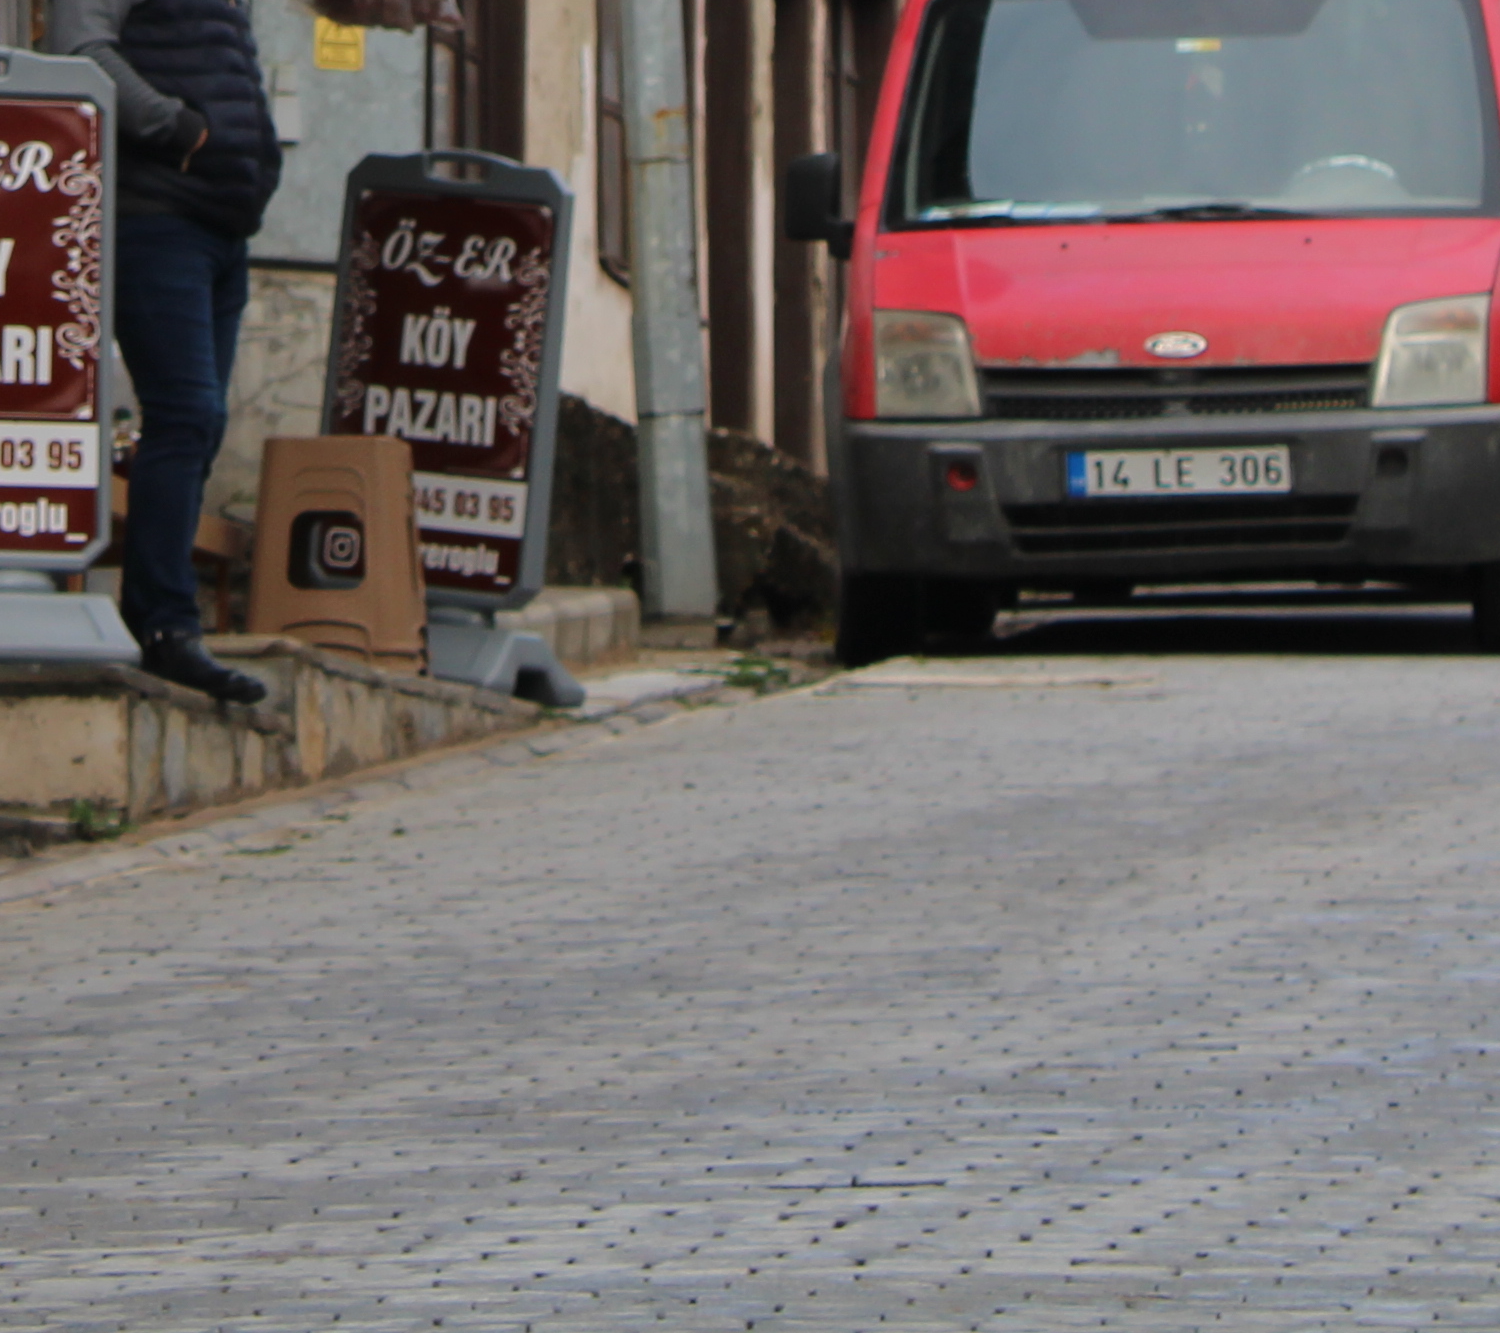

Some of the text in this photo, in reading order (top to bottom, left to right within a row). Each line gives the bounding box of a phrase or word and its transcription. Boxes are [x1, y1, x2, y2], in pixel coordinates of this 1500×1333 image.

[381, 218, 518, 287] ÖZ-ER
[400, 306, 476, 370] KÖY
[363, 384, 499, 447] PAZARI
[0, 438, 35, 469] 03
[46, 440, 83, 471] 95
[1094, 454, 1283, 489] 14 LE 306
[454, 492, 481, 519] 03
[487, 496, 515, 523] 95
